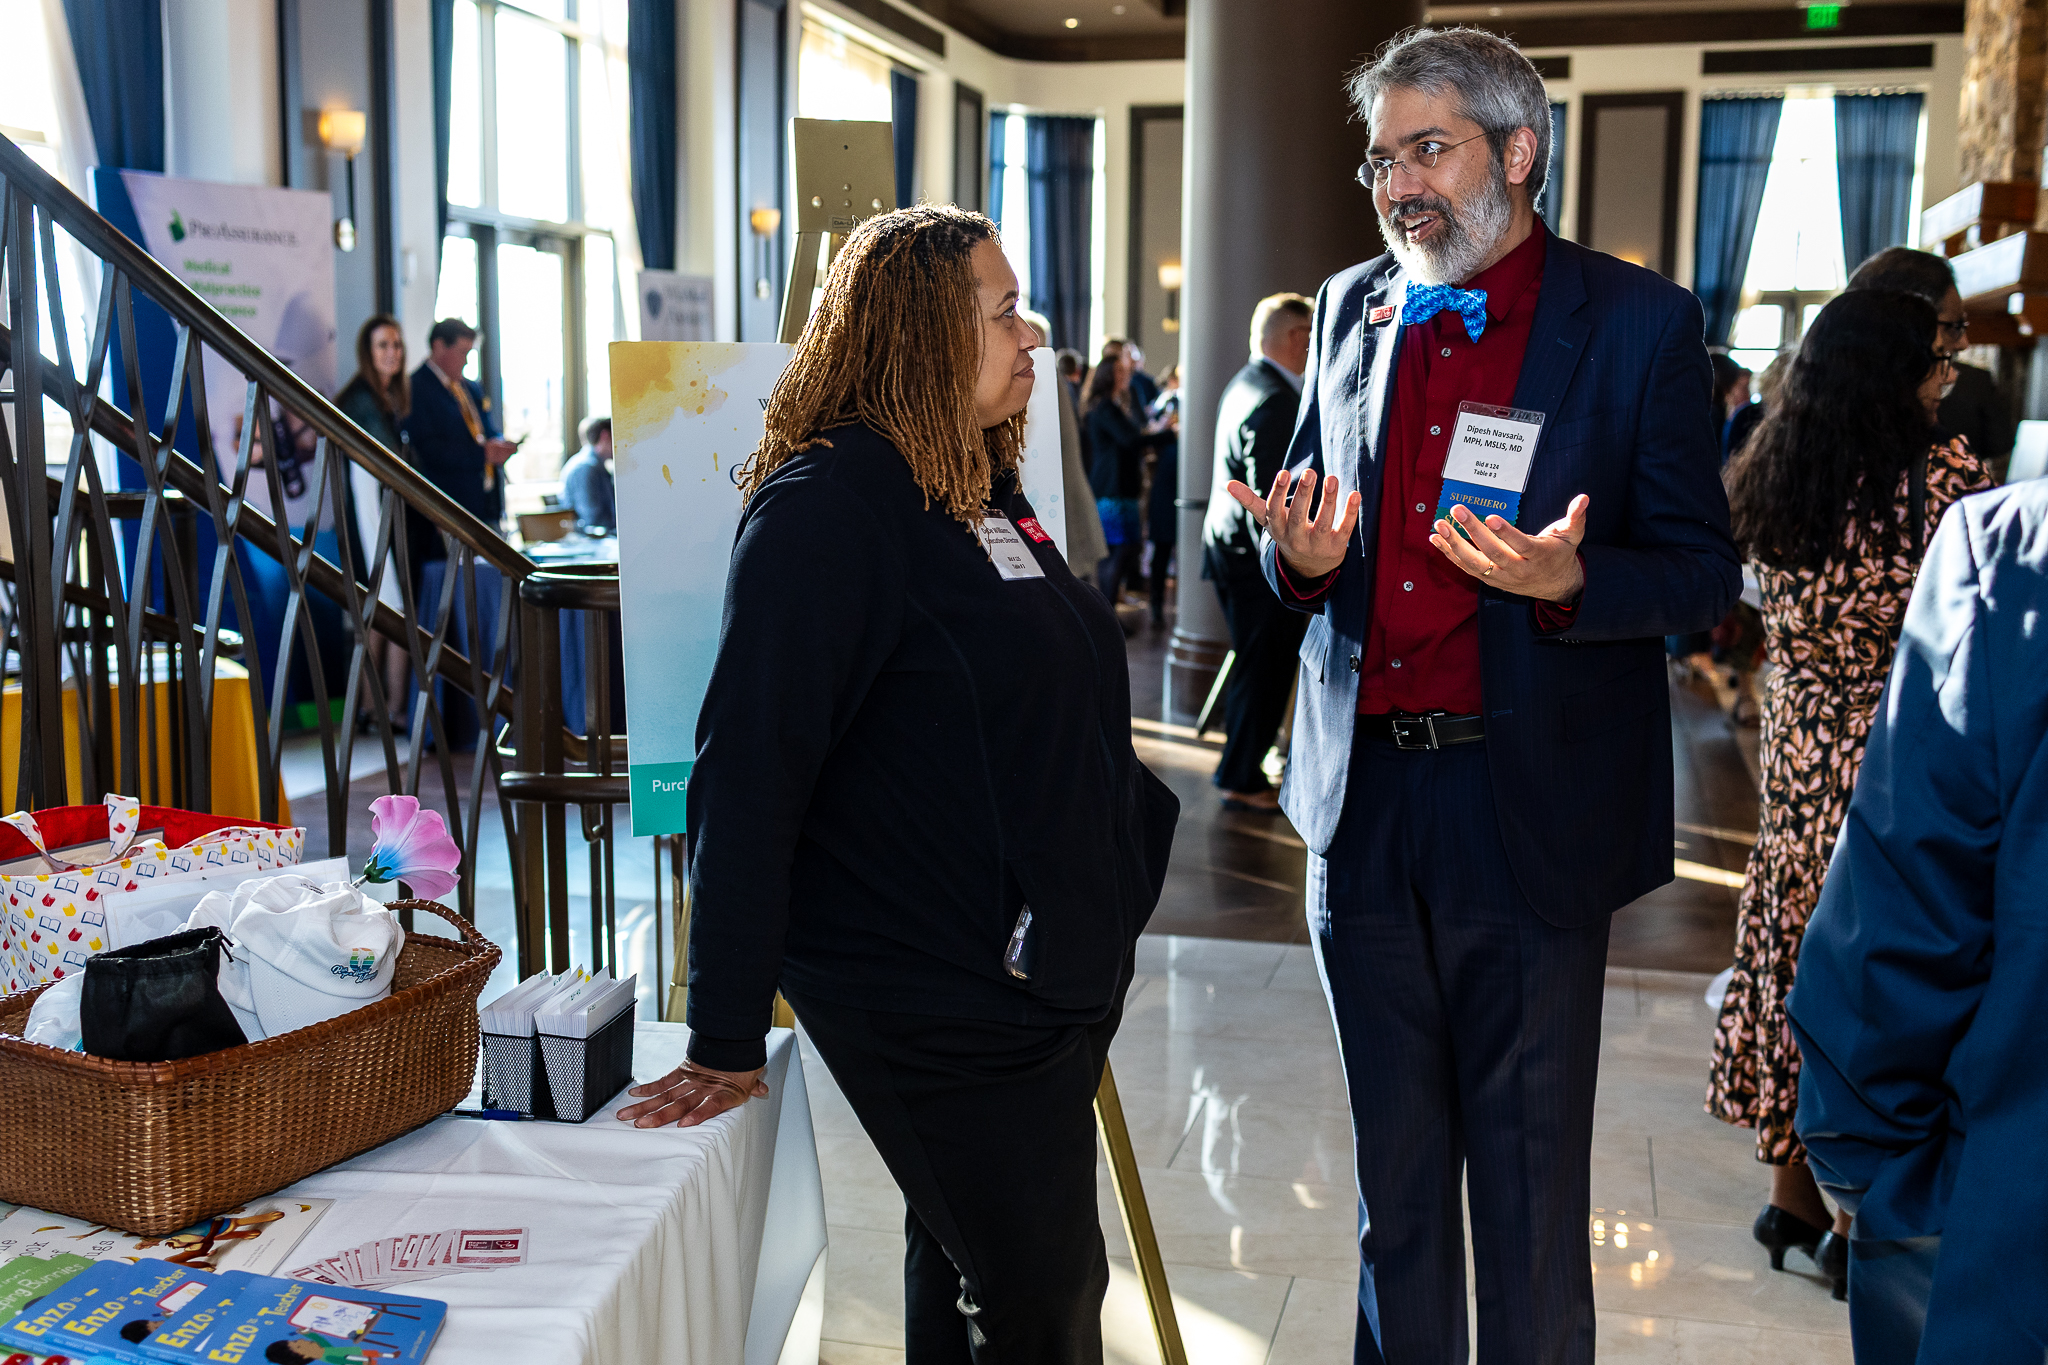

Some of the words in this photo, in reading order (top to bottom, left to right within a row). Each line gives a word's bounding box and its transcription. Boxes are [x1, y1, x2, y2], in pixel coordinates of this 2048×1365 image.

[1466, 424, 1491, 436] Dipesh
[1492, 429, 1525, 442] Navsaria,
[1463, 435, 1483, 447] MPH,
[1484, 439, 1508, 451] MSLIS,
[1509, 444, 1523, 453] MD
[1473, 469, 1488, 477] Table
[1475, 460, 1484, 468] Bid
[1449, 492, 1507, 510] SUPERHERO
[82, 1240, 115, 1260] ugs
[17, 1262, 85, 1290] Bunnies
[62, 1301, 126, 1336] Enzo
[129, 1269, 187, 1298] Teacher
[13, 1302, 78, 1336] Enzo
[207, 1324, 259, 1364] Enzo
[256, 1283, 303, 1316] Teacher
[155, 1313, 214, 1348] Enzo
